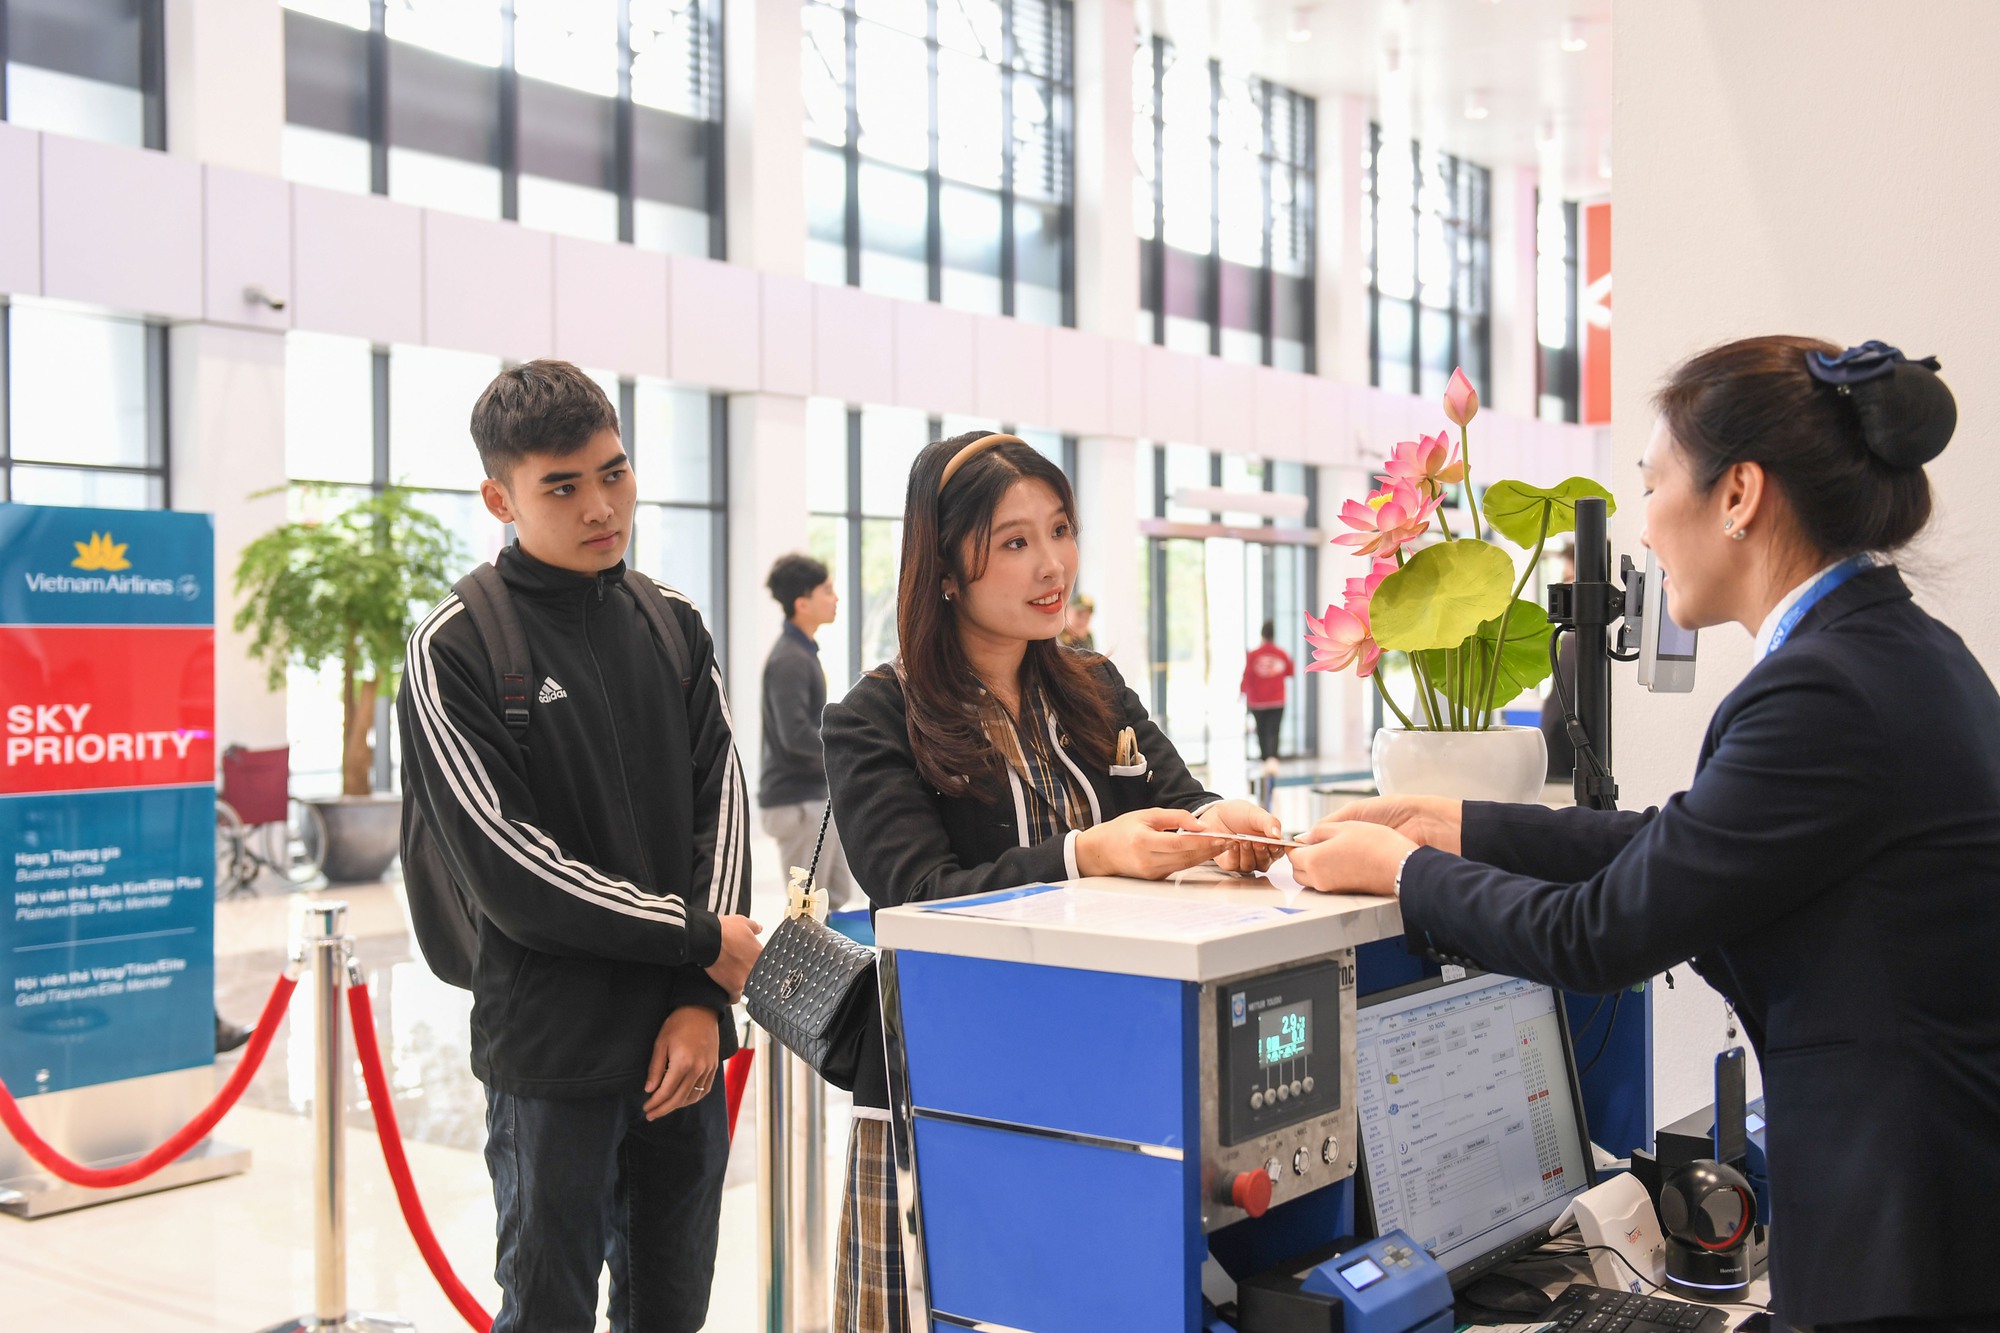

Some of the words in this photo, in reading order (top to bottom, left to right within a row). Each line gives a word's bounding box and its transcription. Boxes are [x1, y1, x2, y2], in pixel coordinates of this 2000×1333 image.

[539, 690, 567, 703] adidas
[7, 703, 91, 734] SKY
[7, 731, 194, 766] PRIORITY
[16, 867, 70, 882] Business
[72, 863, 105, 878] Class
[176, 876, 203, 890] Plus
[98, 899, 123, 913] Plus
[125, 895, 172, 910] Member
[126, 976, 173, 992] Member
[1719, 1265, 1742, 1273] Honeywell
